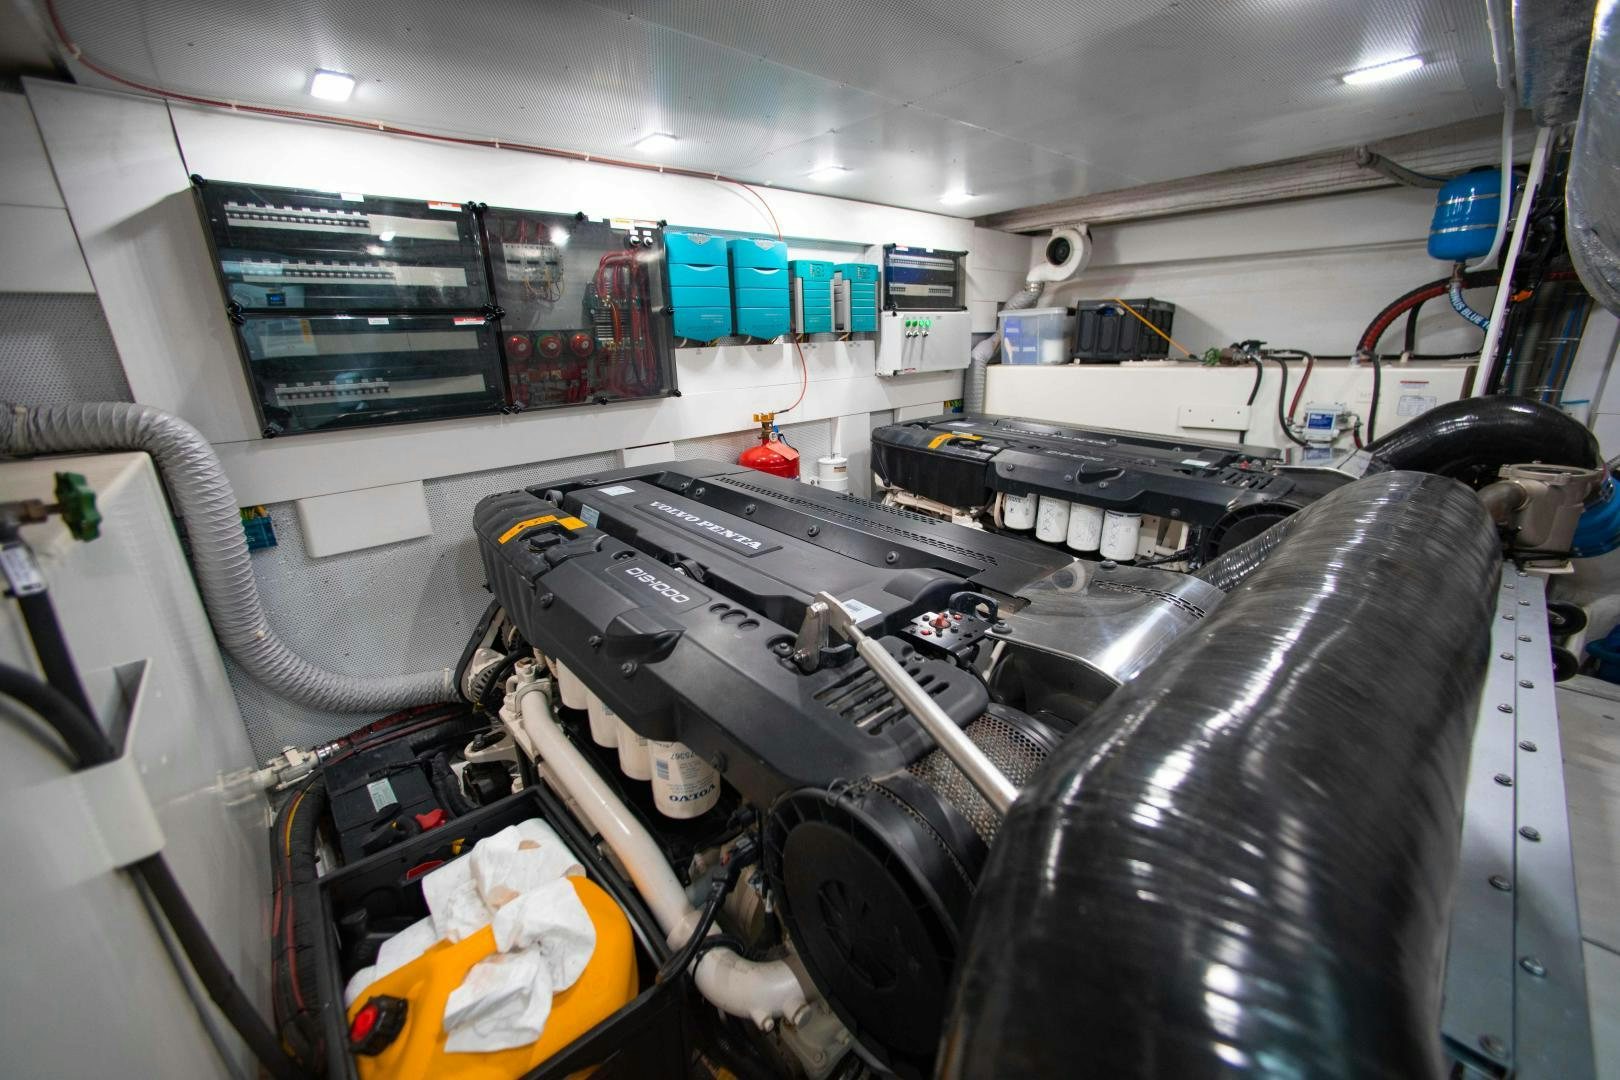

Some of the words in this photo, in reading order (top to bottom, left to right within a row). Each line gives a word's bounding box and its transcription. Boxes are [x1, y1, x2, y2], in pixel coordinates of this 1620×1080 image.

[1460, 308, 1484, 324] BLUE
[649, 501, 699, 524] VOLVO
[698, 520, 762, 550] PENTA
[625, 567, 690, 603] D13-1000
[669, 784, 715, 801] VOLVO
